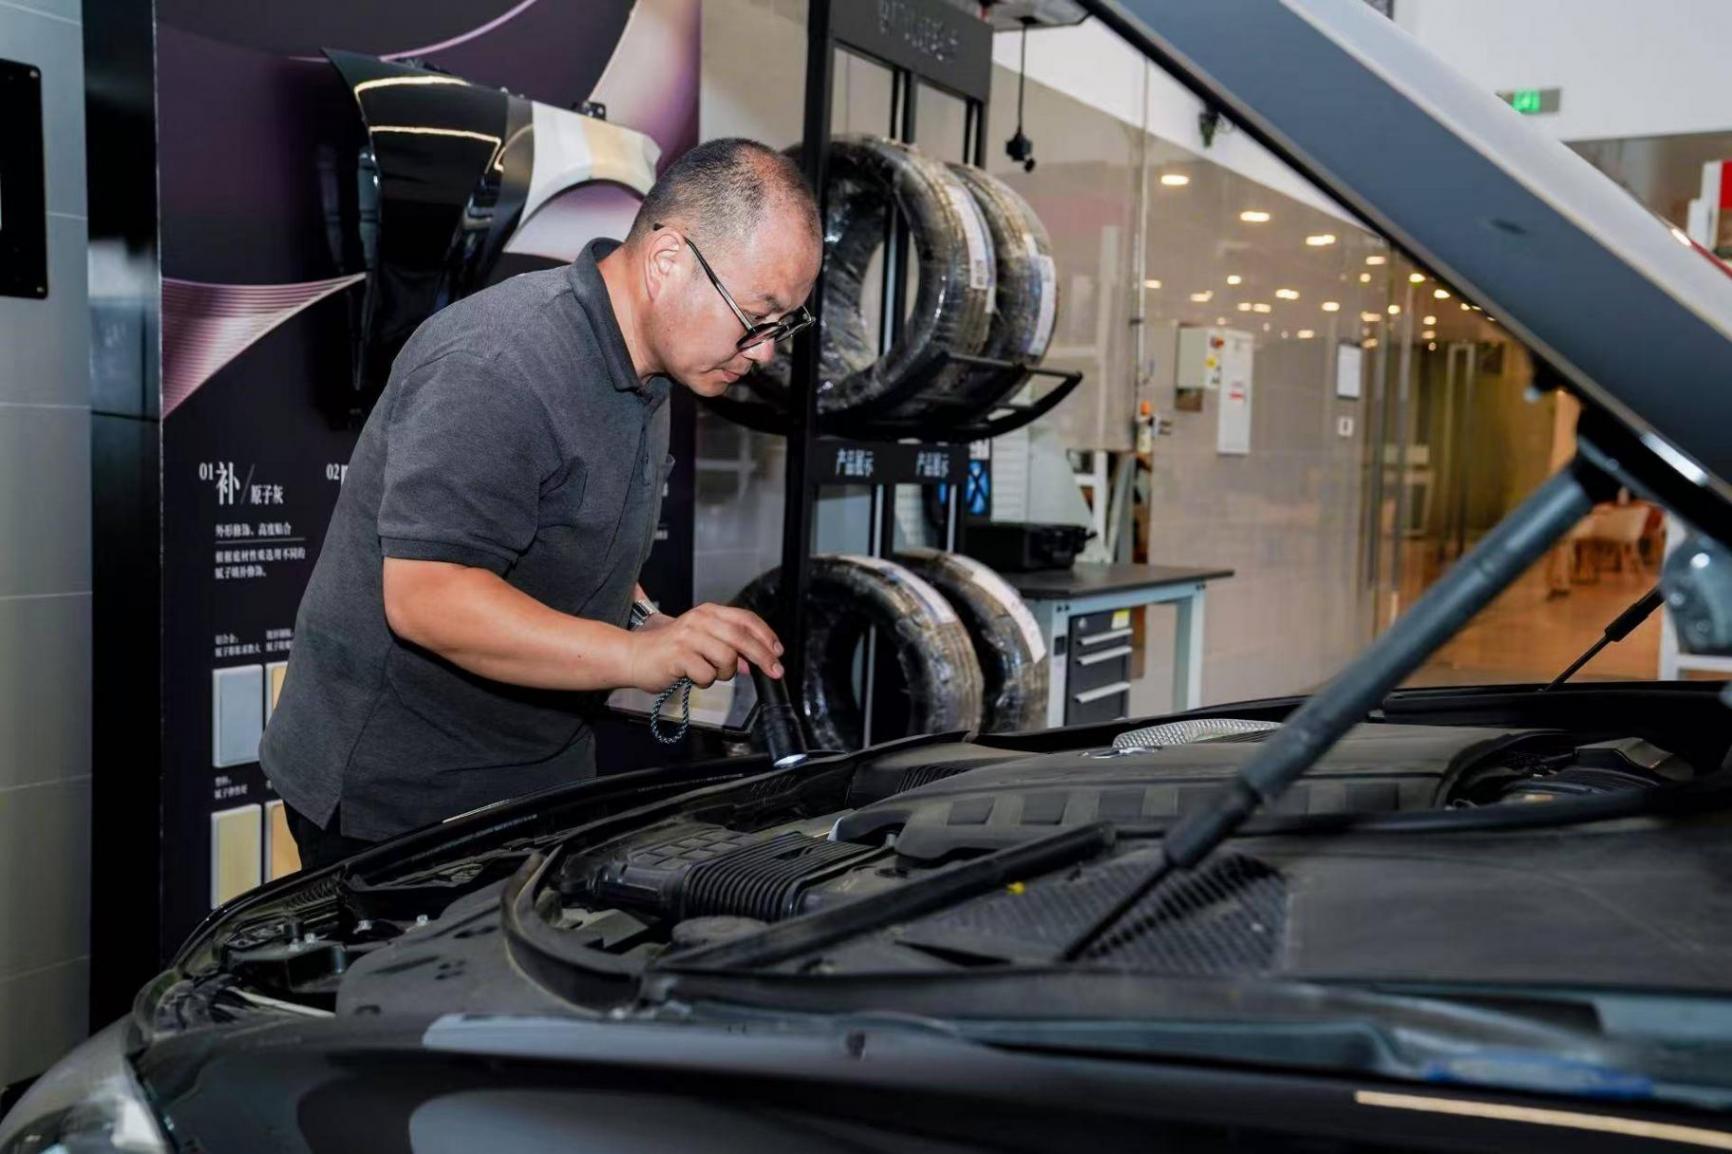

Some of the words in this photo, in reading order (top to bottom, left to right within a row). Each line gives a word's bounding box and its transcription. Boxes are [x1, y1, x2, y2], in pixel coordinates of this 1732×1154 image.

[326, 463, 340, 481] 02
[835, 448, 874, 477] 产品展示
[915, 450, 950, 478] 产品展示
[198, 462, 214, 480] 01
[215, 461, 241, 506] 补
[250, 484, 284, 505] 原子灰
